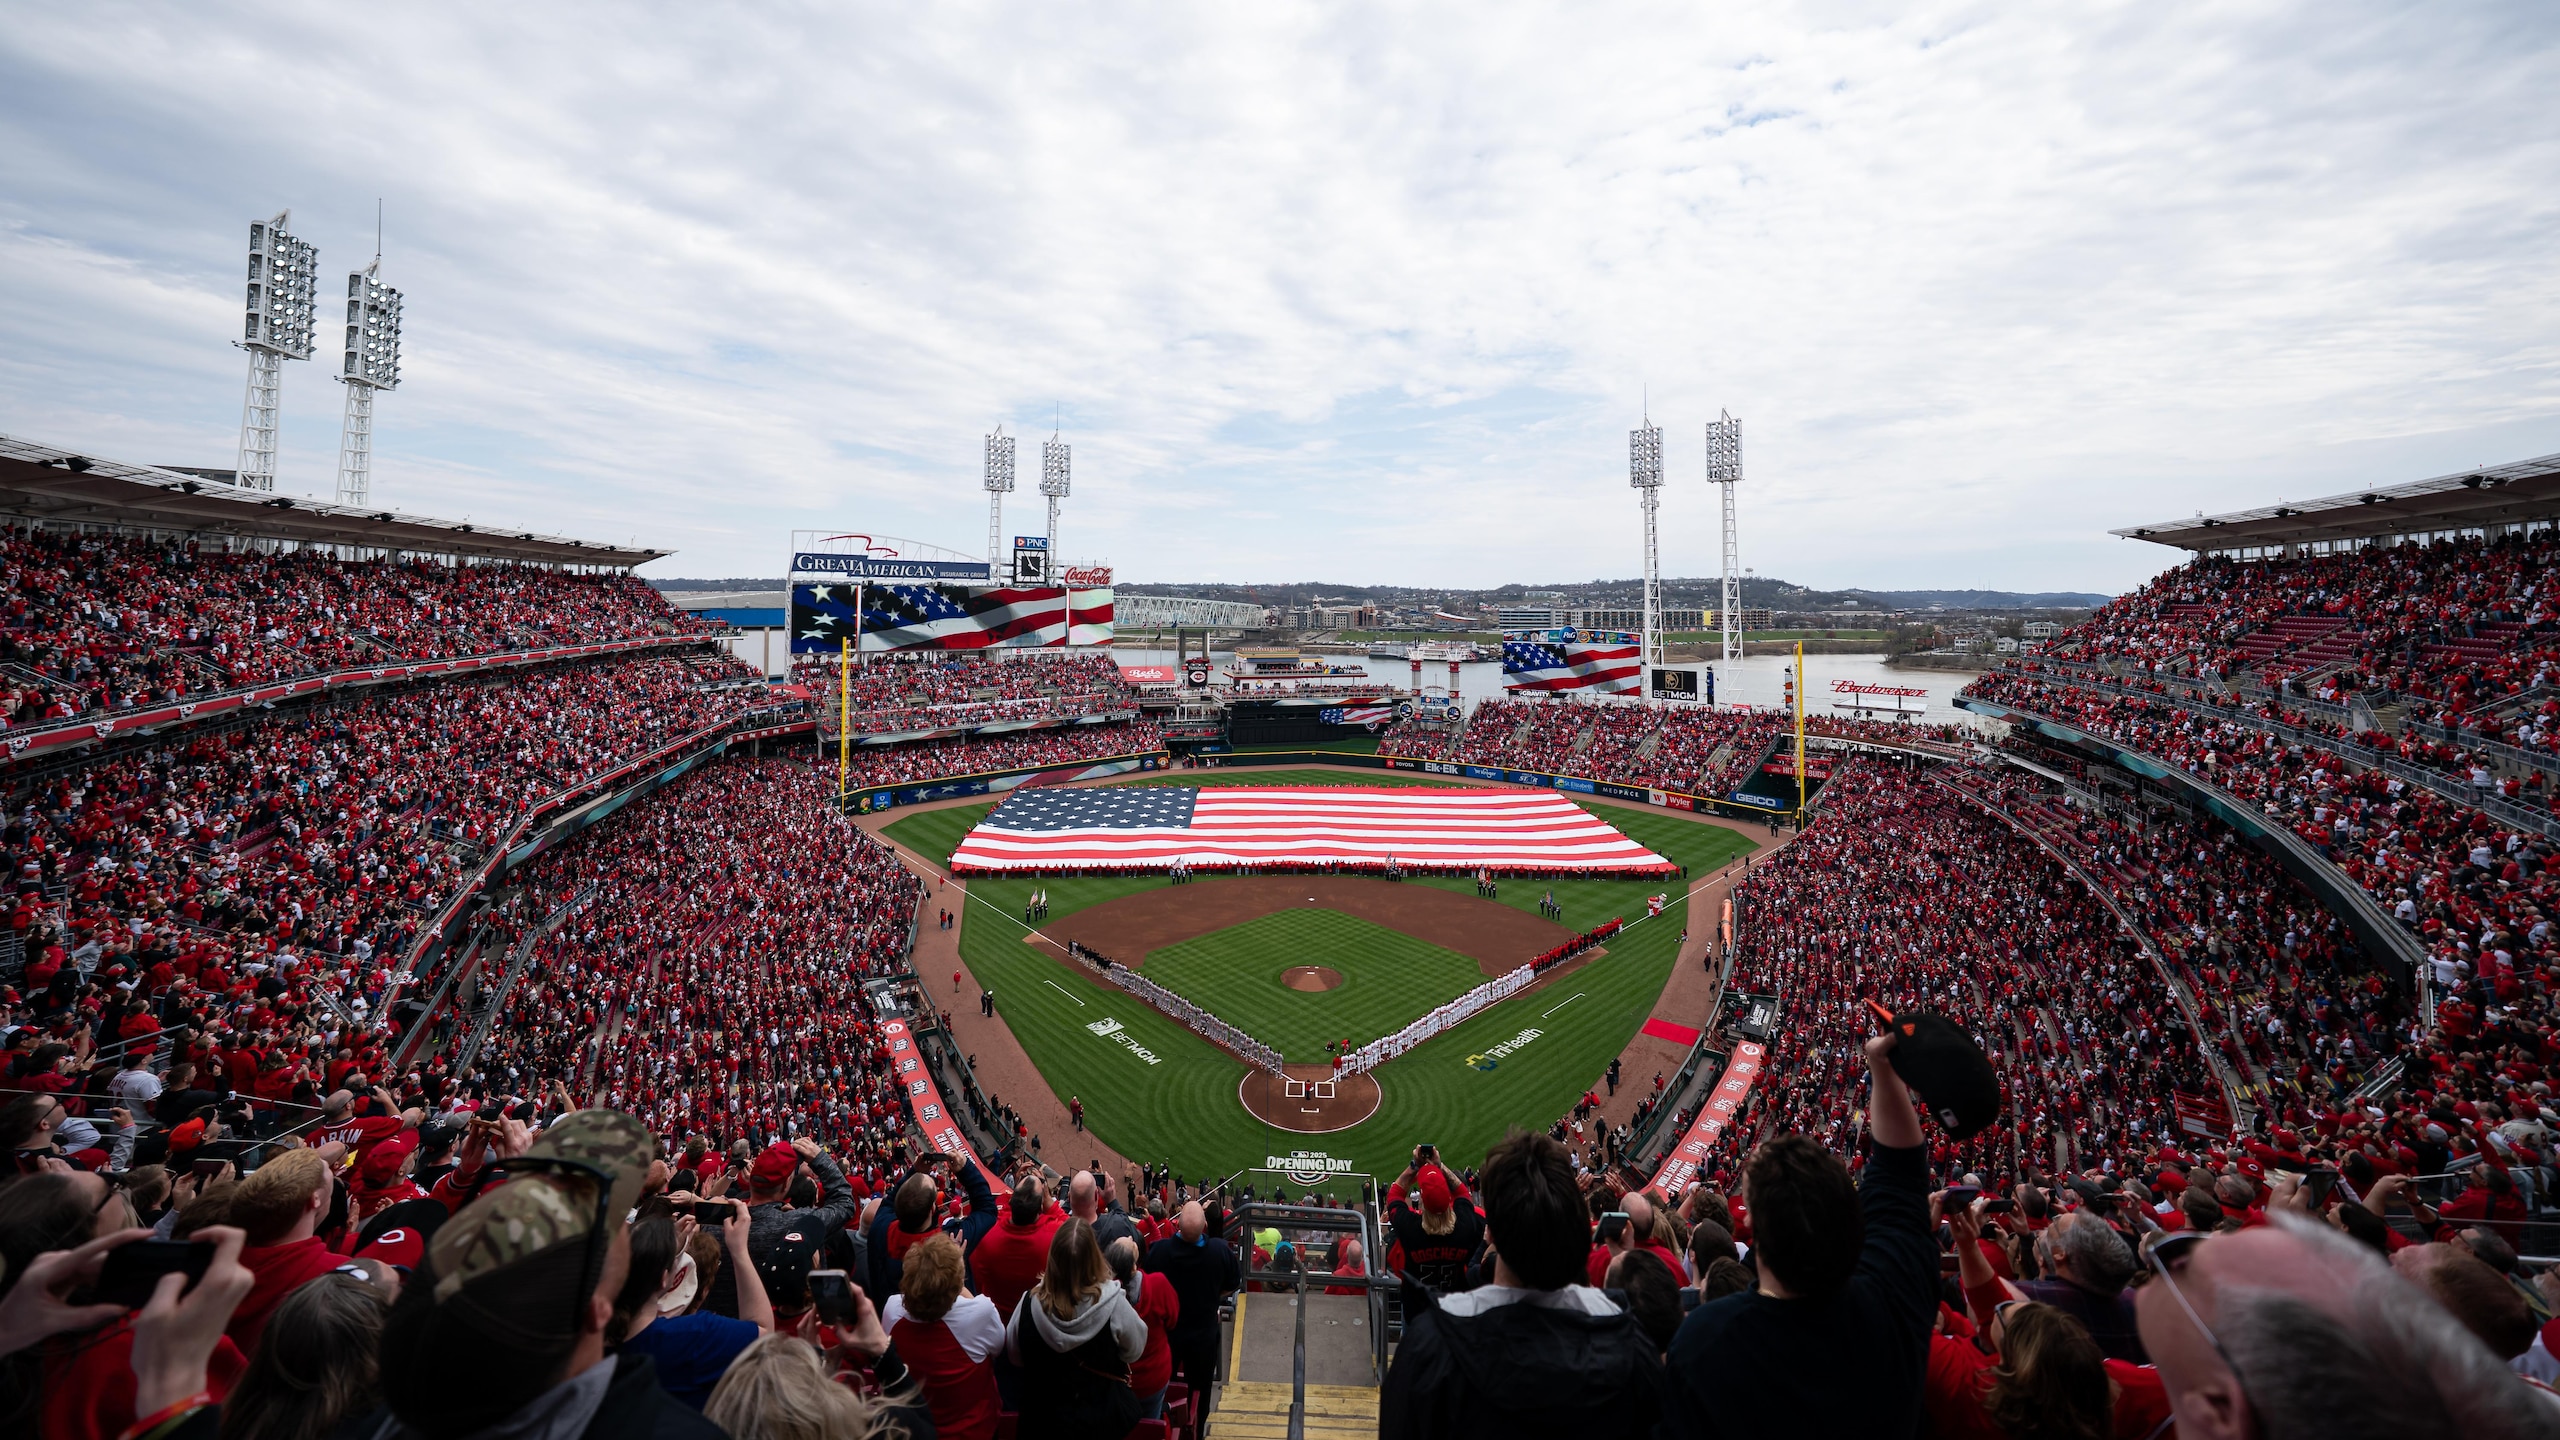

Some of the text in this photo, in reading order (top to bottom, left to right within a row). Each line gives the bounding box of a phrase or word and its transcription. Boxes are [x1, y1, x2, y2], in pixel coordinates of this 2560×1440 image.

[1026, 538, 1047, 547] PNC
[797, 555, 935, 577] GREAT AMERICAN
[1065, 566, 1113, 585] Coca-Cola
[1129, 668, 1163, 678] Reds
[1653, 689, 1696, 700] BETMGM
[1831, 679, 1929, 698] Budweiser
[1783, 766, 1793, 774] HIT
[1808, 769, 1826, 778] BUDS
[1572, 781, 1594, 790] Elizabeth
[1602, 787, 1640, 798] MEDPACE
[1669, 796, 1691, 807] Wyler
[1736, 793, 1776, 806] GEICO
[1109, 1031, 1162, 1066] BETMGM
[1485, 1028, 1545, 1059] TriHealth
[923, 1105, 941, 1123] 1972
[944, 1126, 964, 1149] NATIONAL
[1266, 1155, 1353, 1171] OPENING DAY
[1655, 1158, 1683, 1188] WORLD SERIES
